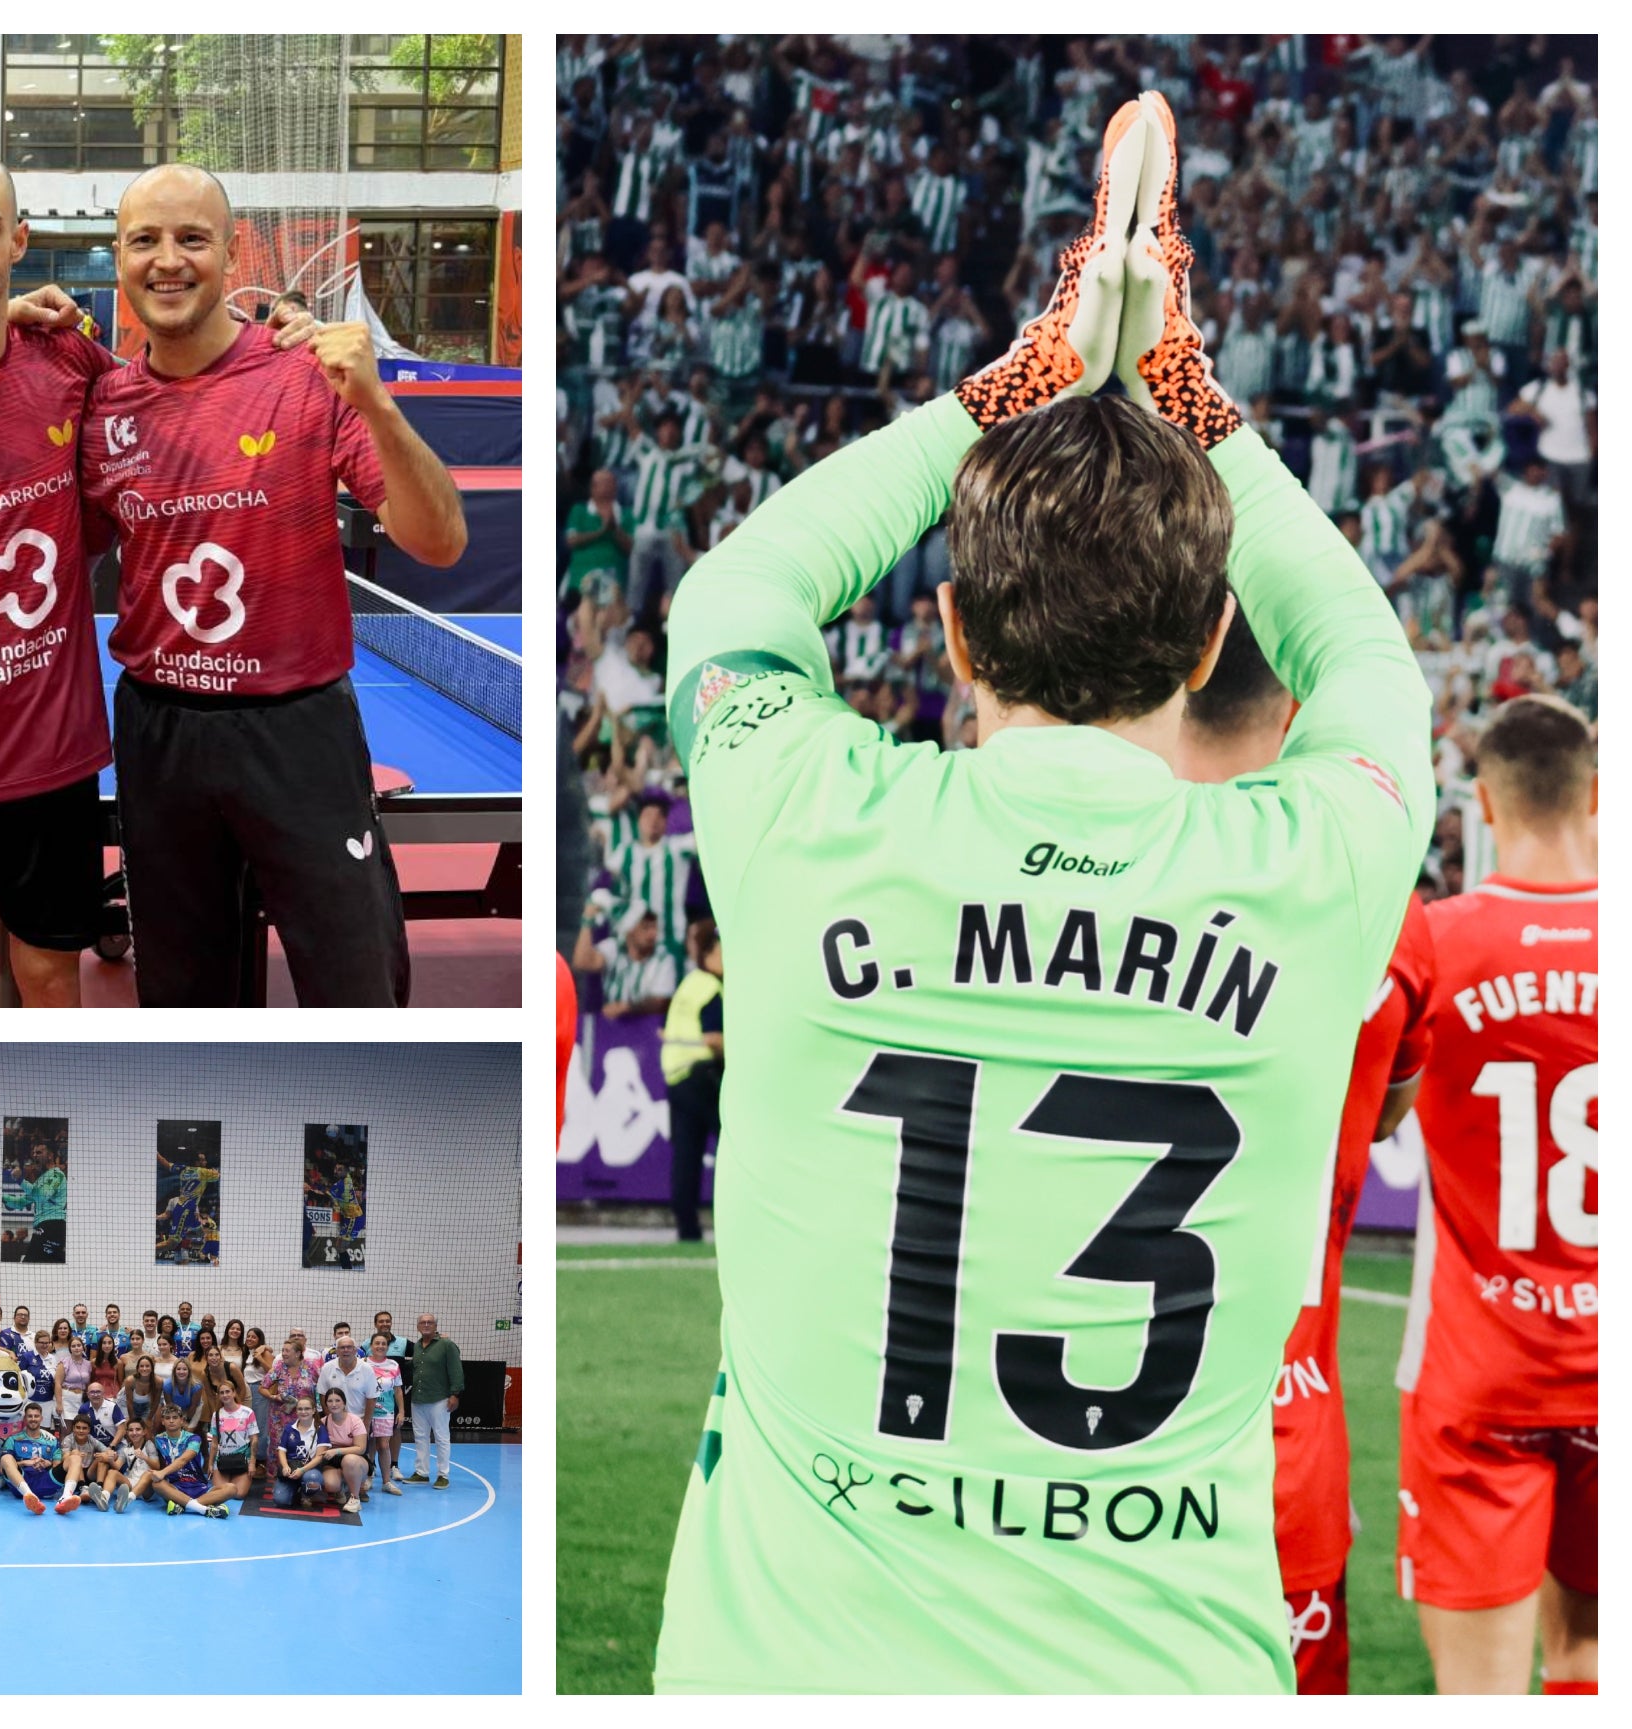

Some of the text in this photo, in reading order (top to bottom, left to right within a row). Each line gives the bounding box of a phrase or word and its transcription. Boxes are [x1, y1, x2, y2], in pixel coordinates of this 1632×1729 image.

[137, 489, 269, 521] LA GARROCHA
[153, 646, 262, 674] fundación
[154, 667, 238, 693] cajasur
[821, 902, 1280, 1039] C. MARÍN
[841, 1051, 1244, 1451] 13
[888, 1472, 1219, 1543] SILBON
